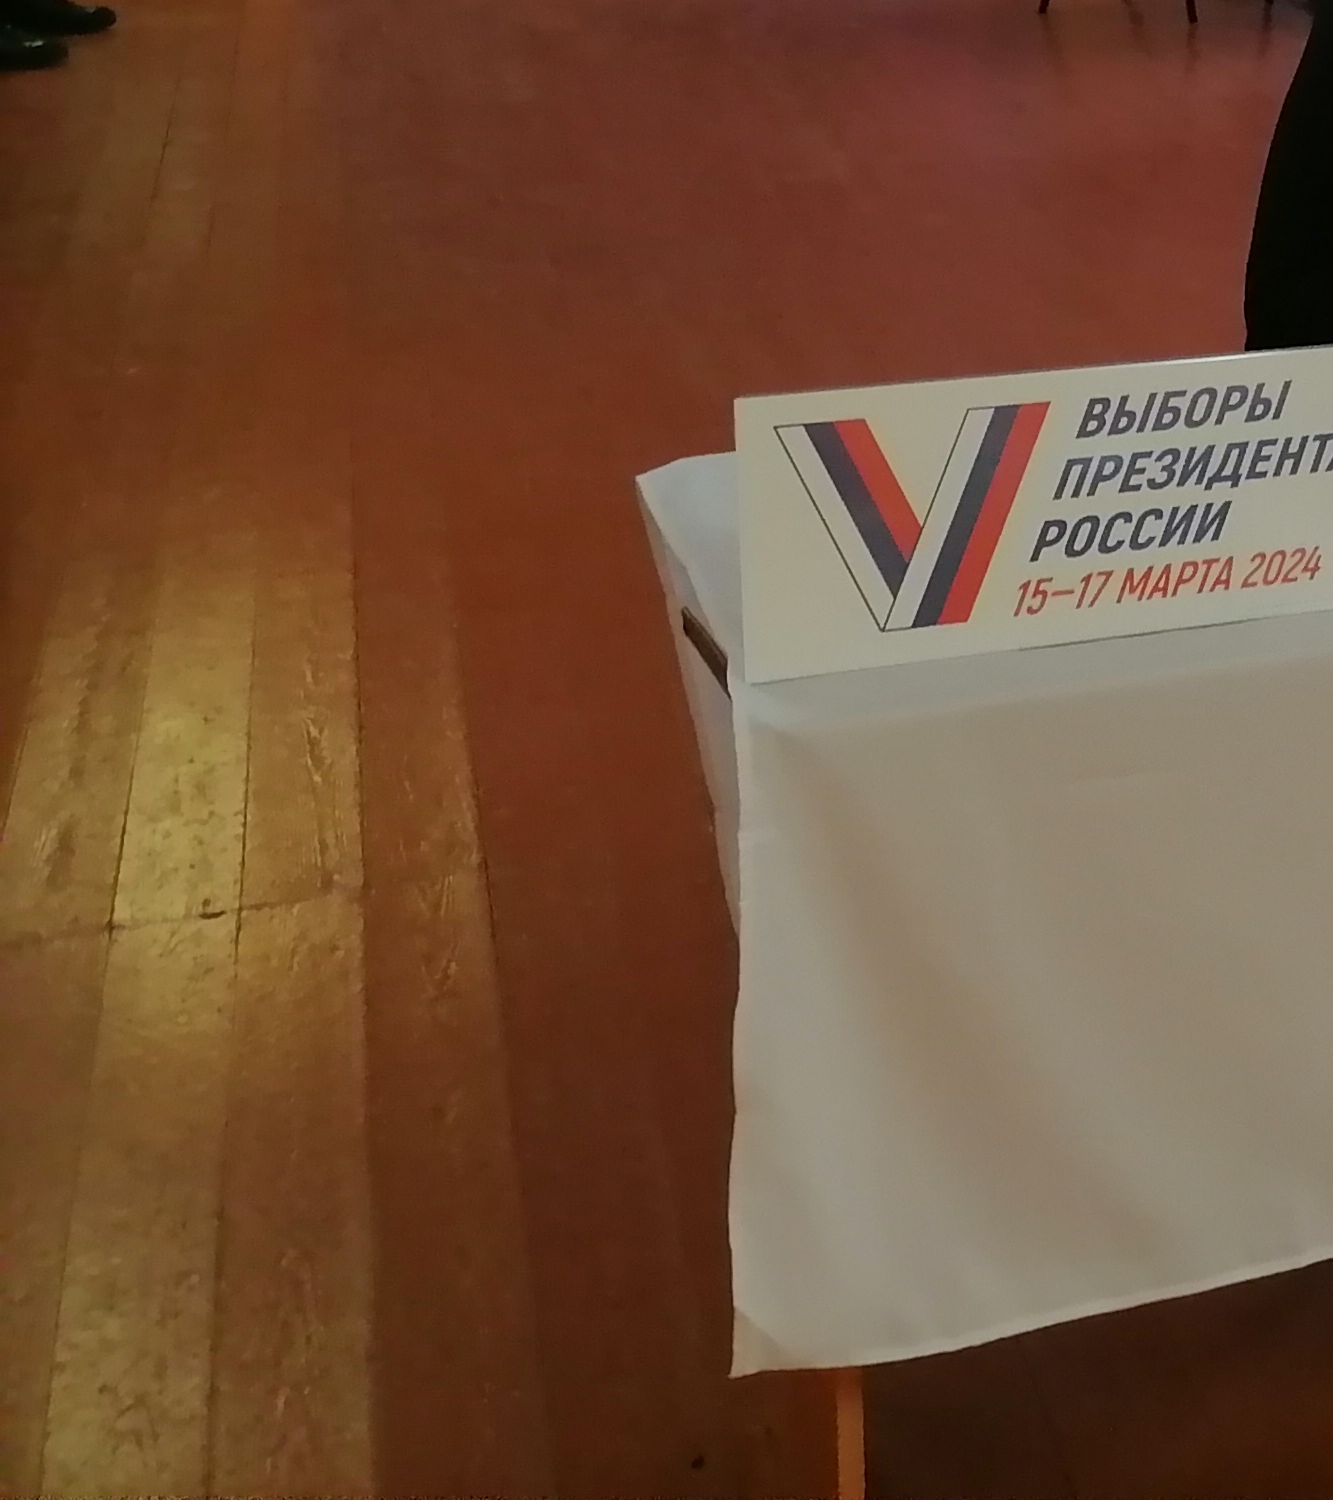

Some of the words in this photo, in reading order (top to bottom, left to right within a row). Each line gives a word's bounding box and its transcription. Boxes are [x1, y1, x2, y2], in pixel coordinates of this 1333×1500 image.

[1076, 380, 1292, 440] ВЫБОРЫ
[1030, 500, 1232, 563] РОССИИ
[1116, 556, 1234, 603] МАРТА
[1240, 545, 1322, 589] 2024
